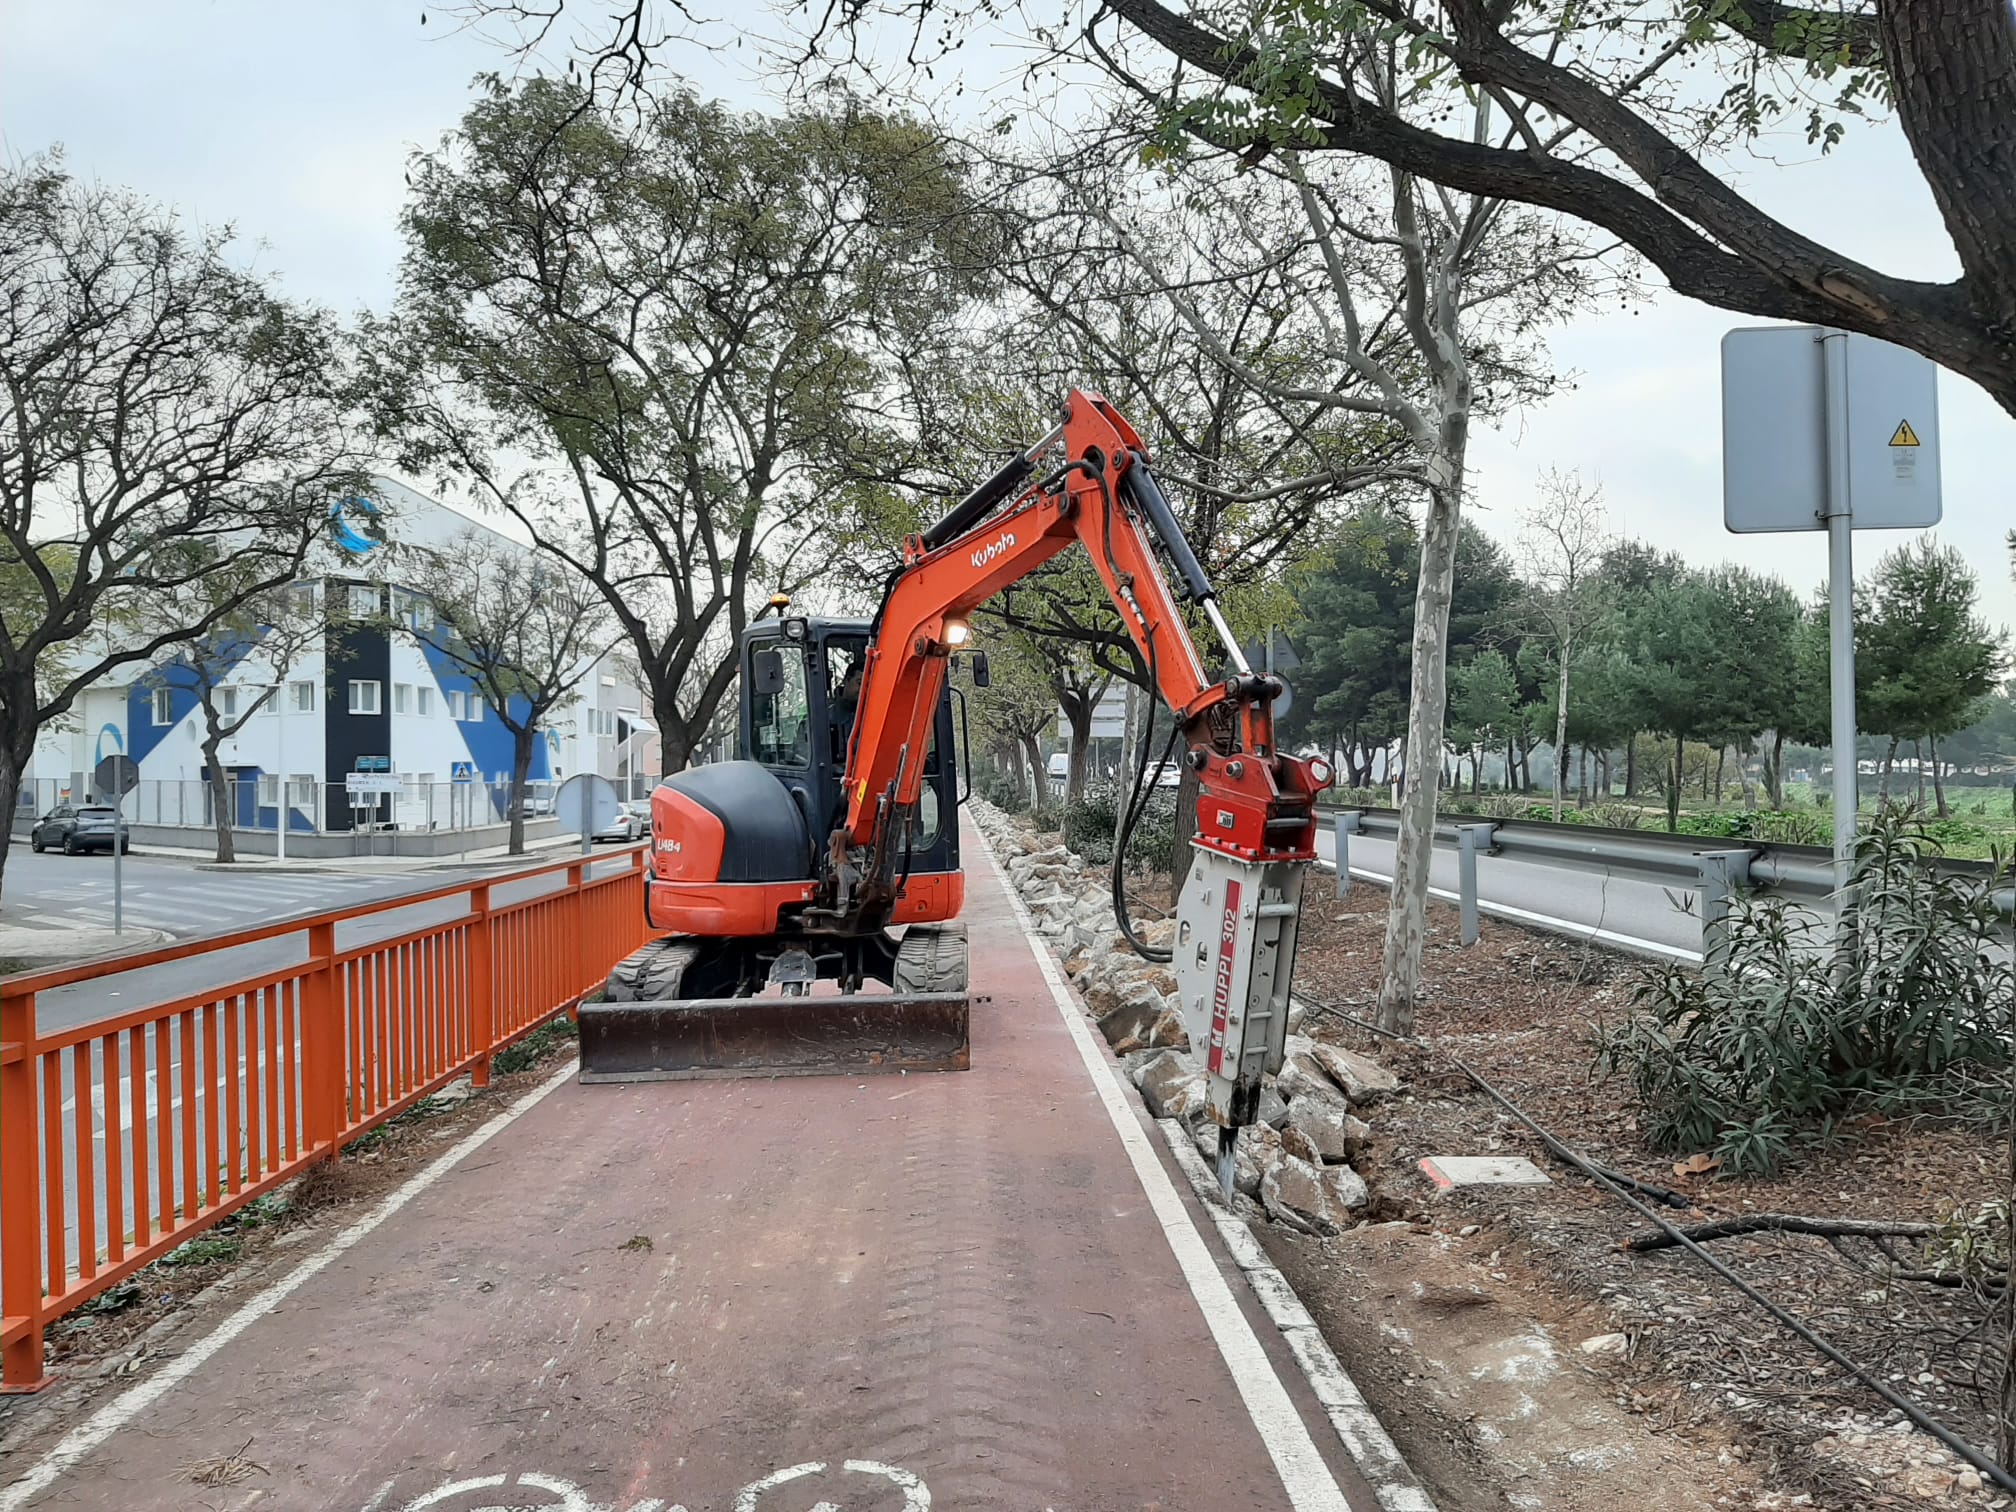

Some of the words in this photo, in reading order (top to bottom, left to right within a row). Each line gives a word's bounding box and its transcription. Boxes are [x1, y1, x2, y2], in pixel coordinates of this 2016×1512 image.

[971, 533, 1015, 567] Kubota
[1222, 908, 1237, 944] 302
[1214, 954, 1232, 1020] HUPPI
